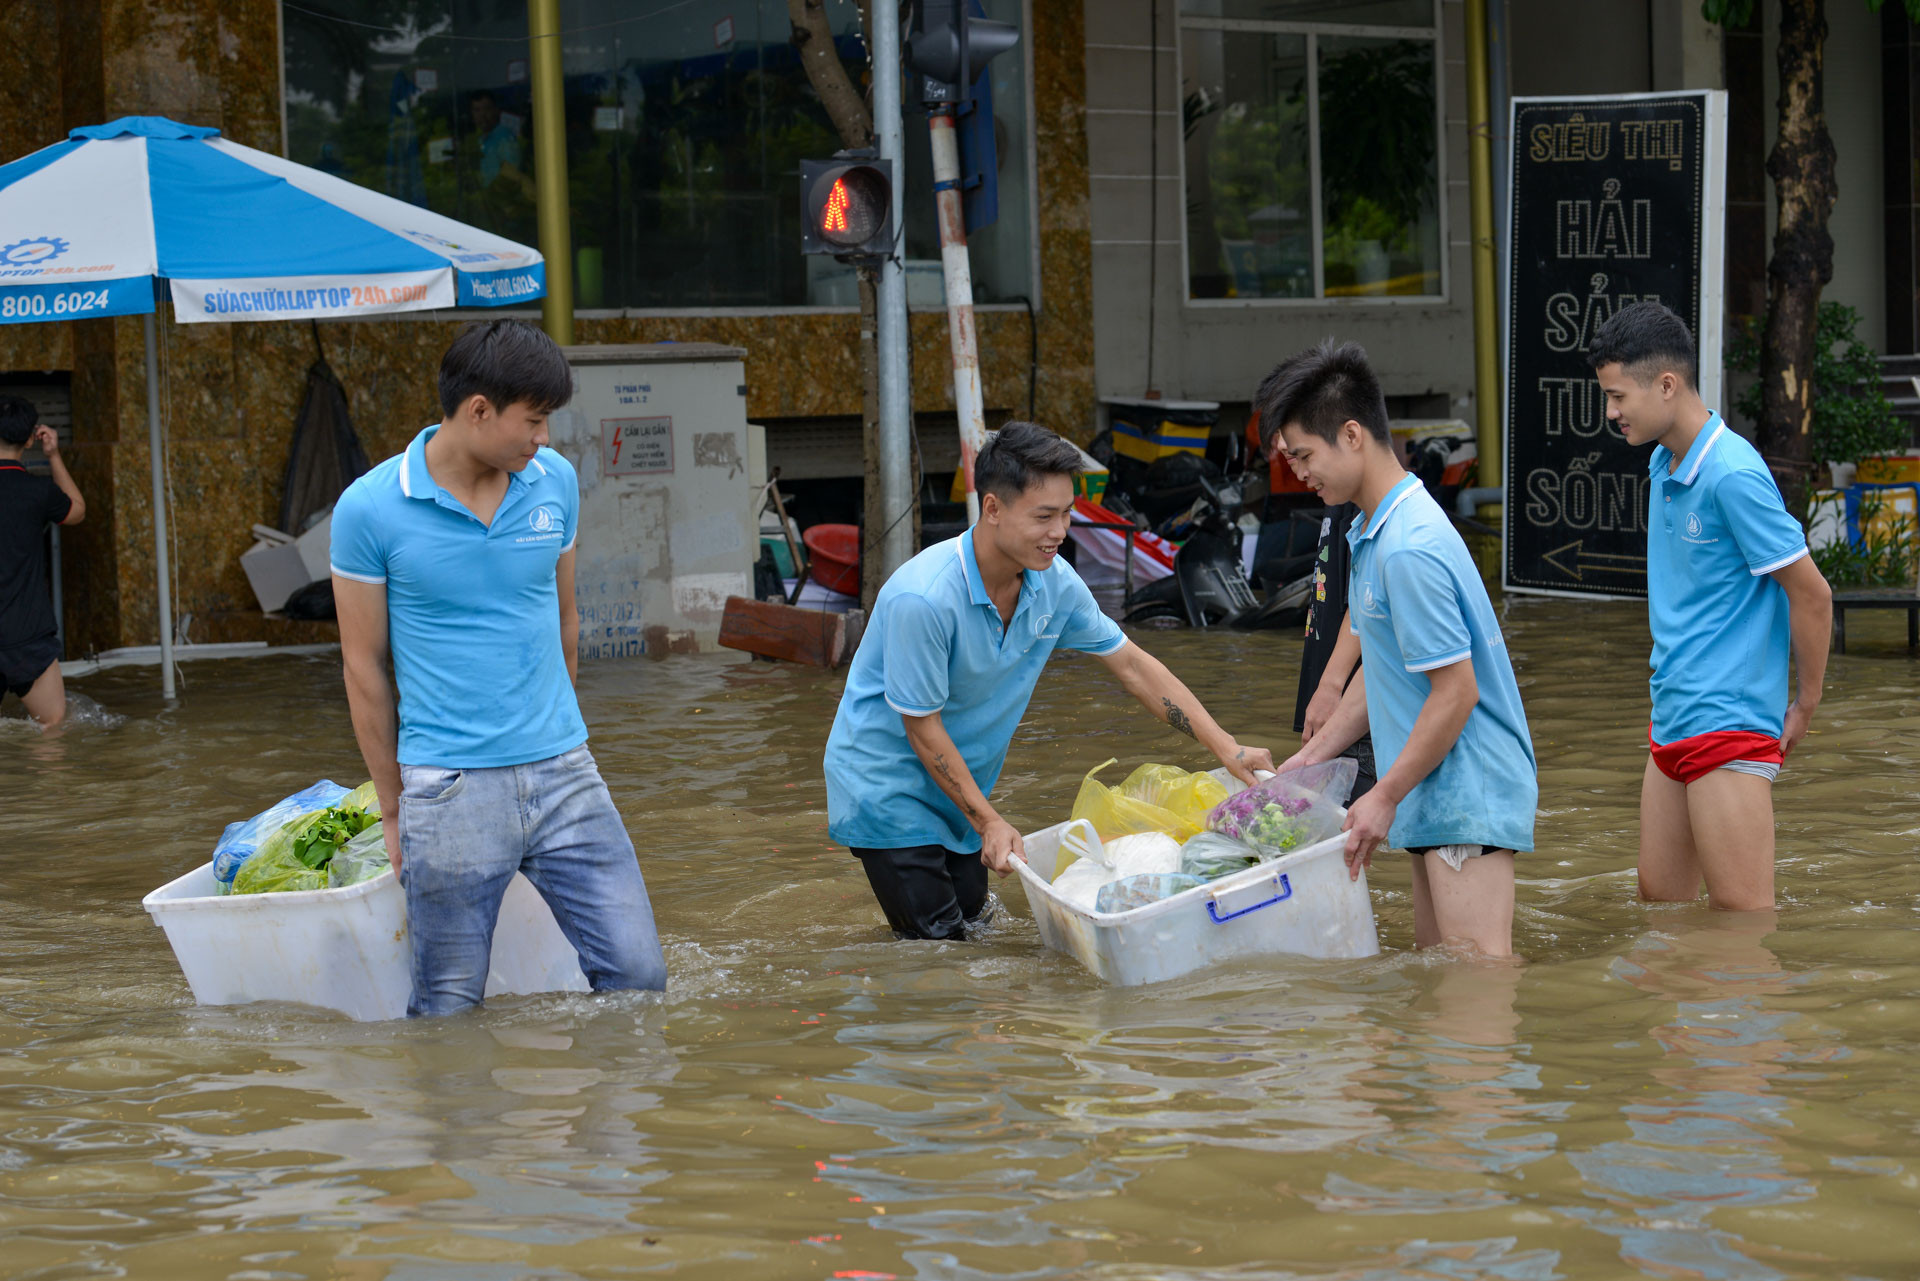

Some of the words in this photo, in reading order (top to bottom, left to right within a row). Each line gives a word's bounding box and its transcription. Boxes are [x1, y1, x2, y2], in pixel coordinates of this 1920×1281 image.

[1529, 112, 1611, 163] SIÊU
[1620, 119, 1684, 171] THỊ
[1556, 178, 1651, 259] HẢI
[1544, 272, 1660, 352] SẢ
[1525, 451, 1650, 533] SỐN
